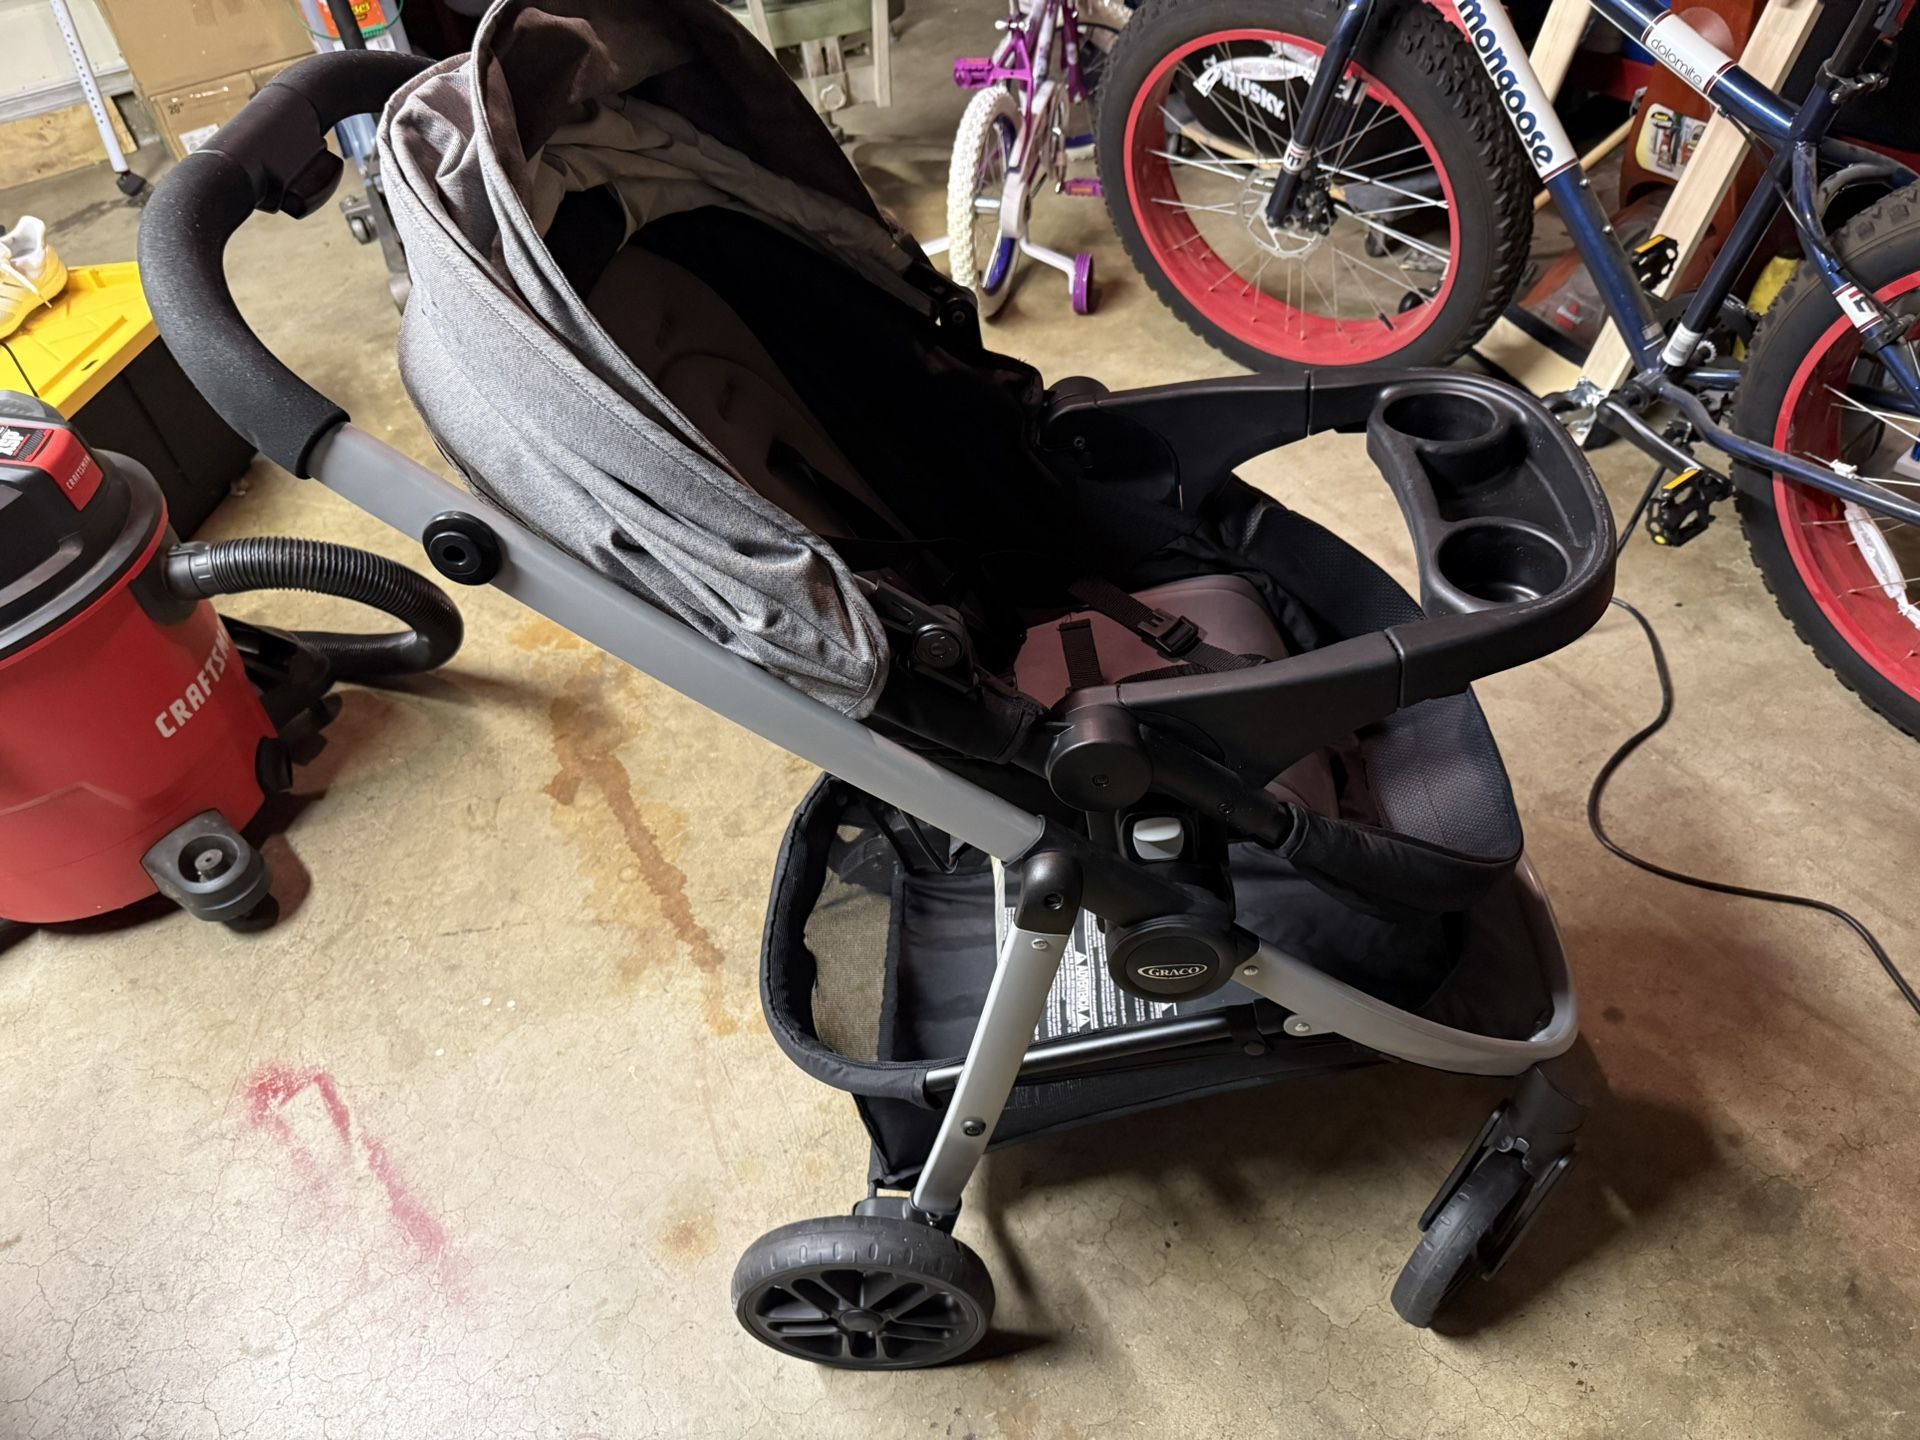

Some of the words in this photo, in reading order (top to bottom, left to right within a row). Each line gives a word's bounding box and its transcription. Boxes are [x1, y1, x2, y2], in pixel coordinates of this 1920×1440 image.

[1458, 0, 1553, 168] mongoose
[1651, 38, 1702, 86] dolomite
[1147, 966, 1200, 977] GRACO
